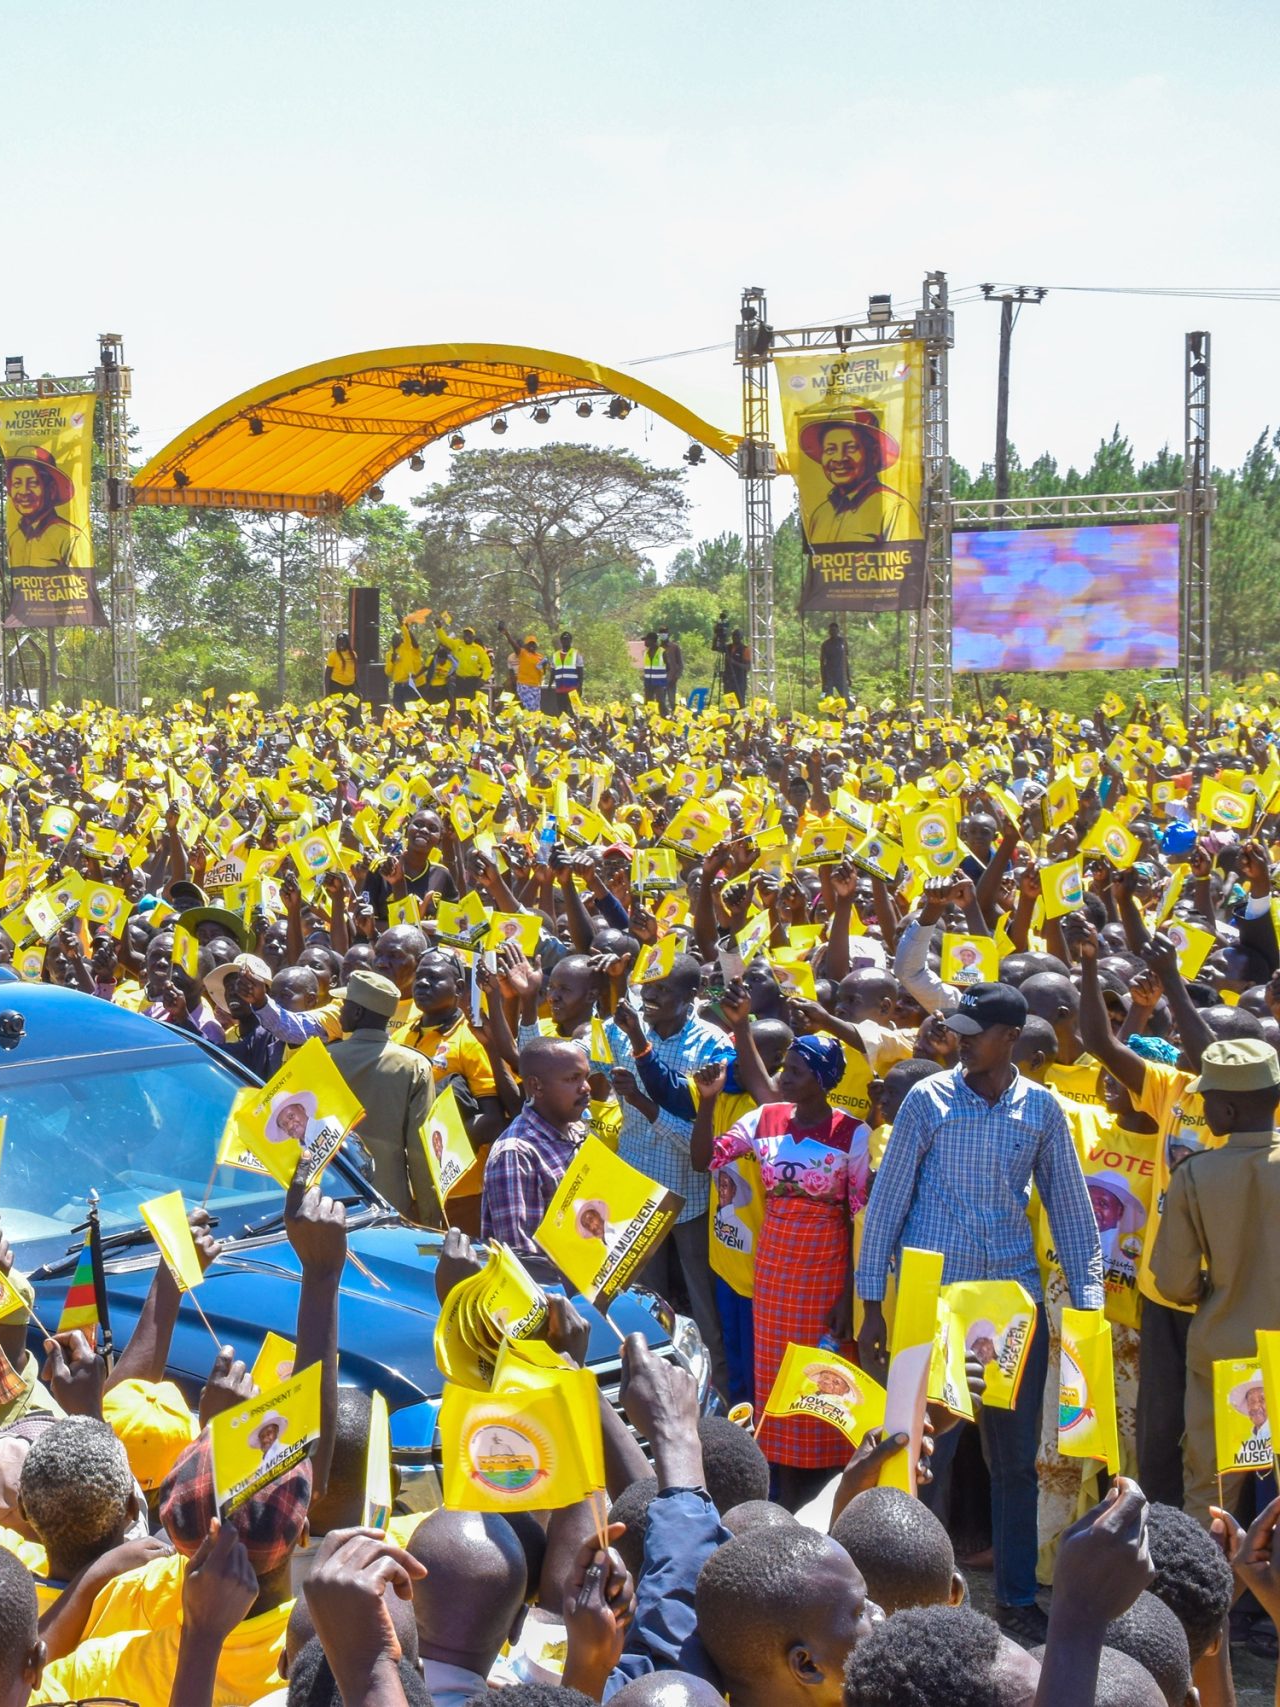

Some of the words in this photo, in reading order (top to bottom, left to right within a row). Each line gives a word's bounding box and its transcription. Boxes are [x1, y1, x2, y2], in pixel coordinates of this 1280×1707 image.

[819, 358, 879, 376] YOWERI
[812, 370, 888, 388] MUSEVENI
[820, 385, 870, 396] PRESIDENT
[6, 417, 66, 429] MUSEVENI
[14, 408, 61, 420] YOWERI
[10, 428, 50, 436] PRESIDENT
[812, 550, 912, 568] PROTECTING
[13, 575, 88, 590] PROTECTING
[820, 568, 852, 582] THE
[856, 566, 904, 582] GAINS
[21, 588, 44, 602] THE
[46, 586, 88, 601] GAINS
[262, 1078, 287, 1110] PRESIDENT
[1088, 1146, 1156, 1176] VOTE
[561, 1174, 584, 1212] PRESIDENT
[591, 1250, 618, 1289] YOWERI
[617, 1198, 658, 1254] MUSEVENI
[603, 1249, 637, 1296] PROTECTING
[634, 1234, 648, 1252] THE
[643, 1210, 664, 1237] GAINS
[1003, 1320, 1028, 1379] MUSEVENI
[832, 1356, 866, 1380] PRESIDENT
[250, 1389, 292, 1416] PRESIDENT
[798, 1394, 844, 1417] YOWERI
[789, 1402, 848, 1428] MUSEVENI
[228, 1466, 263, 1496] YOWERI
[265, 1433, 308, 1472] MUSEVENI
